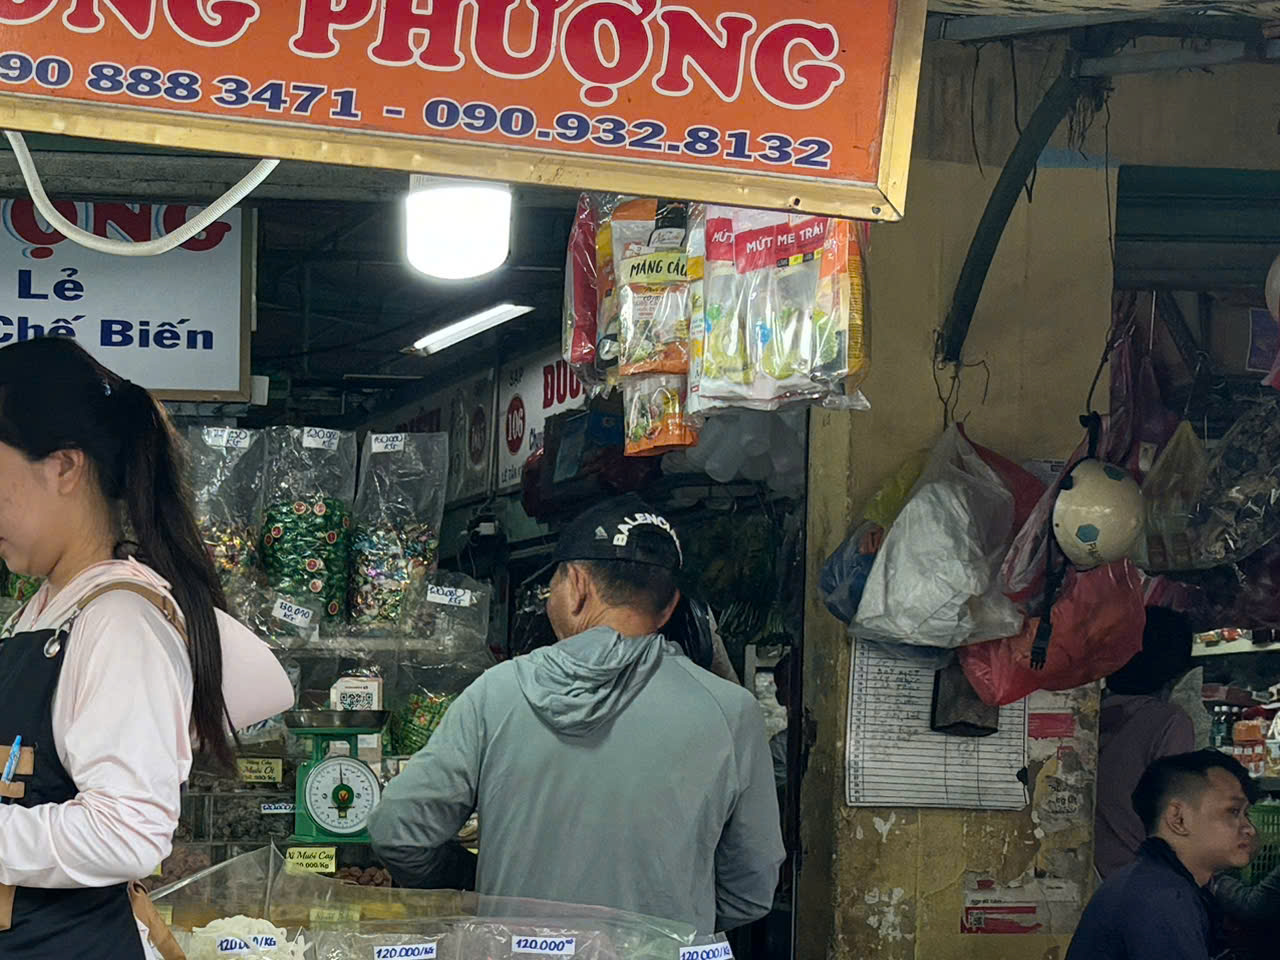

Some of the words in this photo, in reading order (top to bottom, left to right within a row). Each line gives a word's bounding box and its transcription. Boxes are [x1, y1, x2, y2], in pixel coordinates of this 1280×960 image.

[86, 61, 203, 104] 888
[210, 76, 361, 121] 3471
[423, 98, 833, 170] 090.932.8132
[777, 232, 796, 247] ME
[17, 267, 86, 302] Lẻ
[100, 318, 215, 351] Biến
